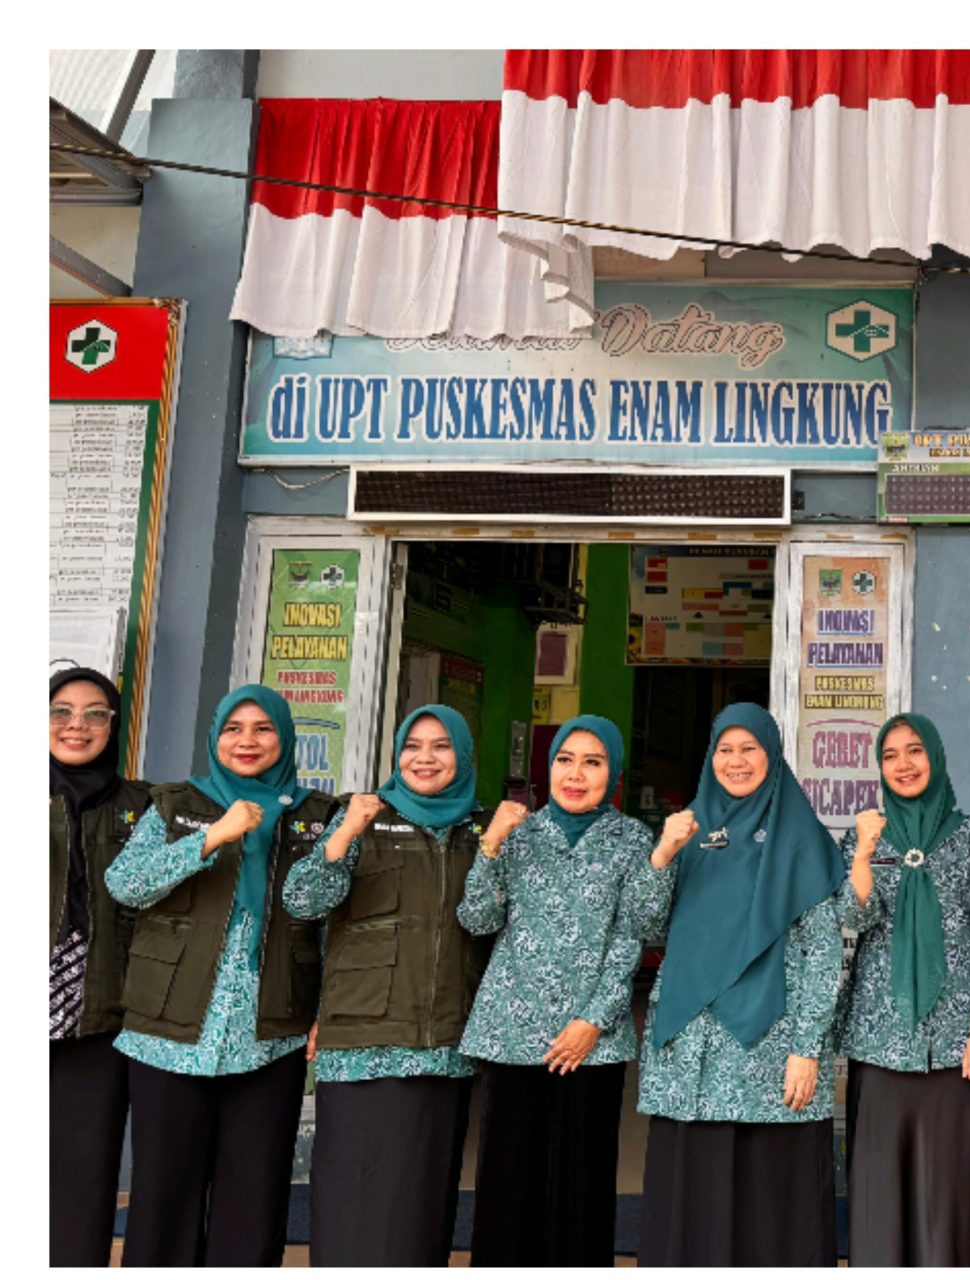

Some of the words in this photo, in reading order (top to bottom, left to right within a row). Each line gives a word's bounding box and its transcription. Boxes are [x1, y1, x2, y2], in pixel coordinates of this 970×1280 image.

[600, 303, 786, 368] Datang
[270, 376, 308, 440] di
[319, 376, 388, 440] UPT
[397, 376, 598, 441] PUSKESMAS
[608, 379, 704, 443] ENAM
[713, 380, 891, 445] LINGKUNG
[283, 603, 342, 628] INOVASI
[817, 609, 876, 634] INOVASI
[271, 635, 348, 660] PELAYANAN
[808, 642, 884, 667] PELAYANAN
[296, 733, 330, 772] TOL
[812, 730, 873, 769] GEBET
